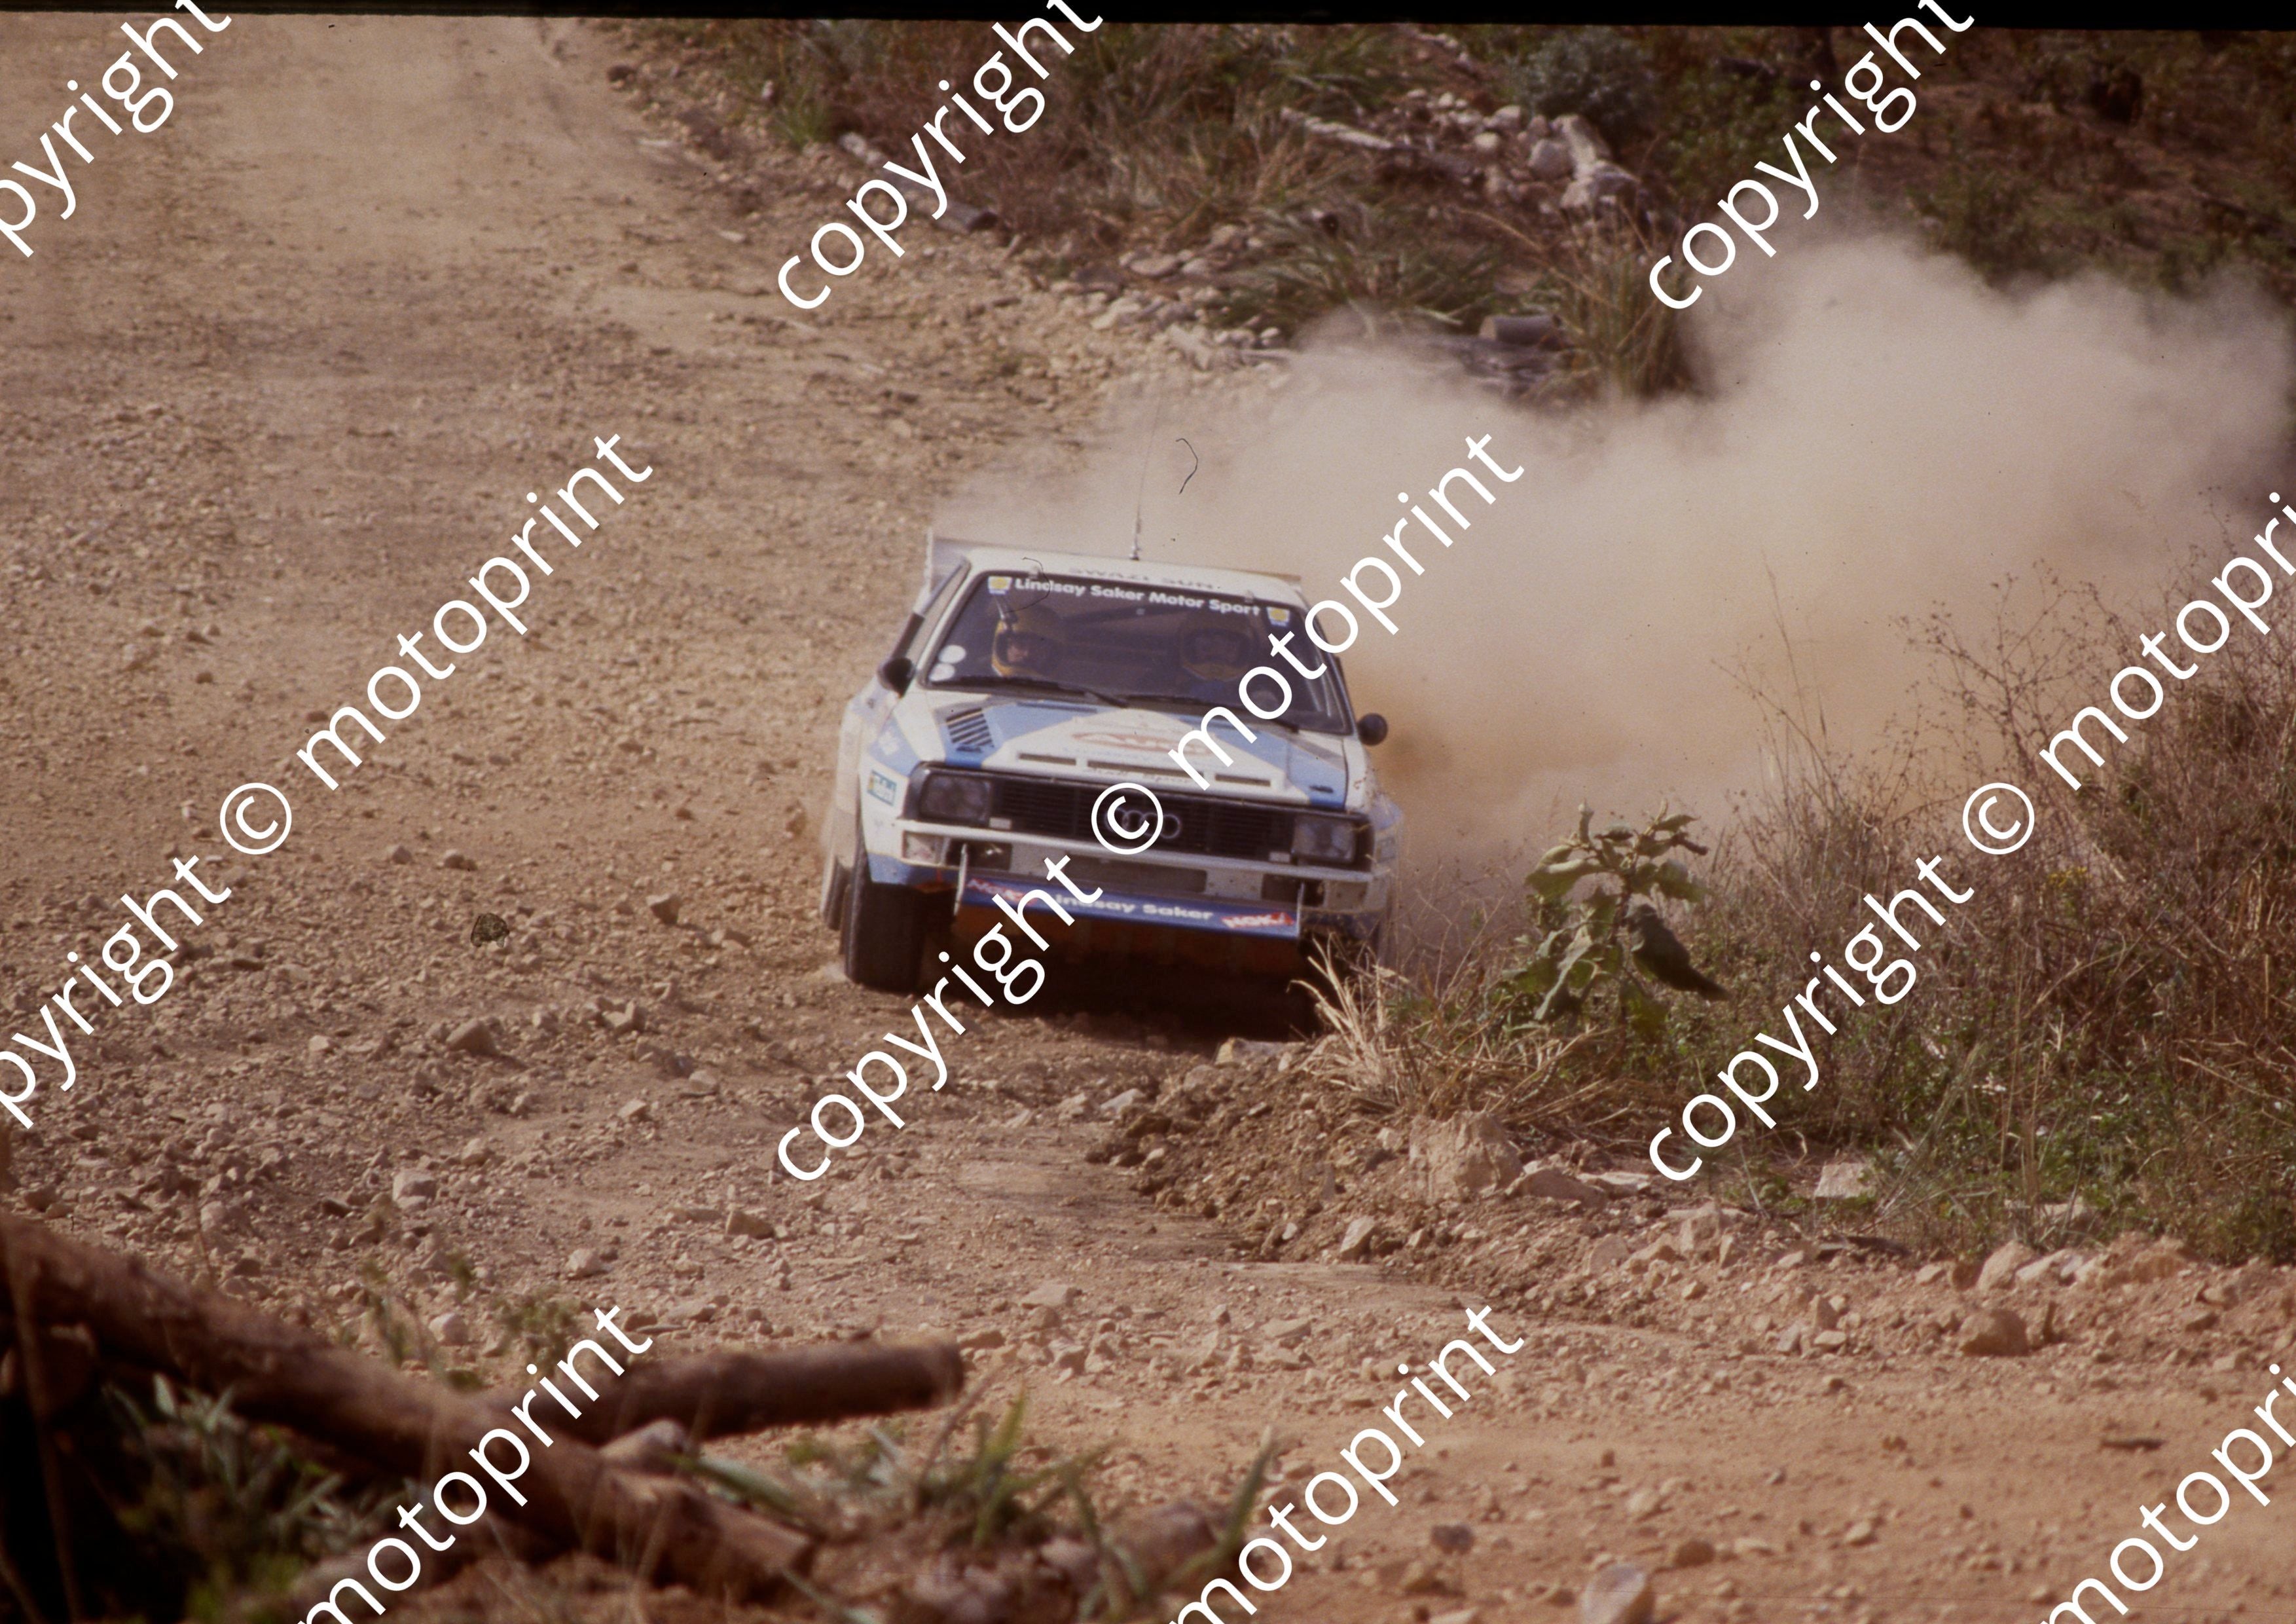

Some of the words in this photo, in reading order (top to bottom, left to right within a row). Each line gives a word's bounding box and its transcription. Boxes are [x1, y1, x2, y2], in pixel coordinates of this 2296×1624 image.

[1014, 578, 1085, 597] Lindsay
[1090, 584, 1146, 602] Saker
[1148, 591, 1205, 609] Motor
[1209, 599, 1261, 616] Sport
[1142, 903, 1214, 921] Saker
